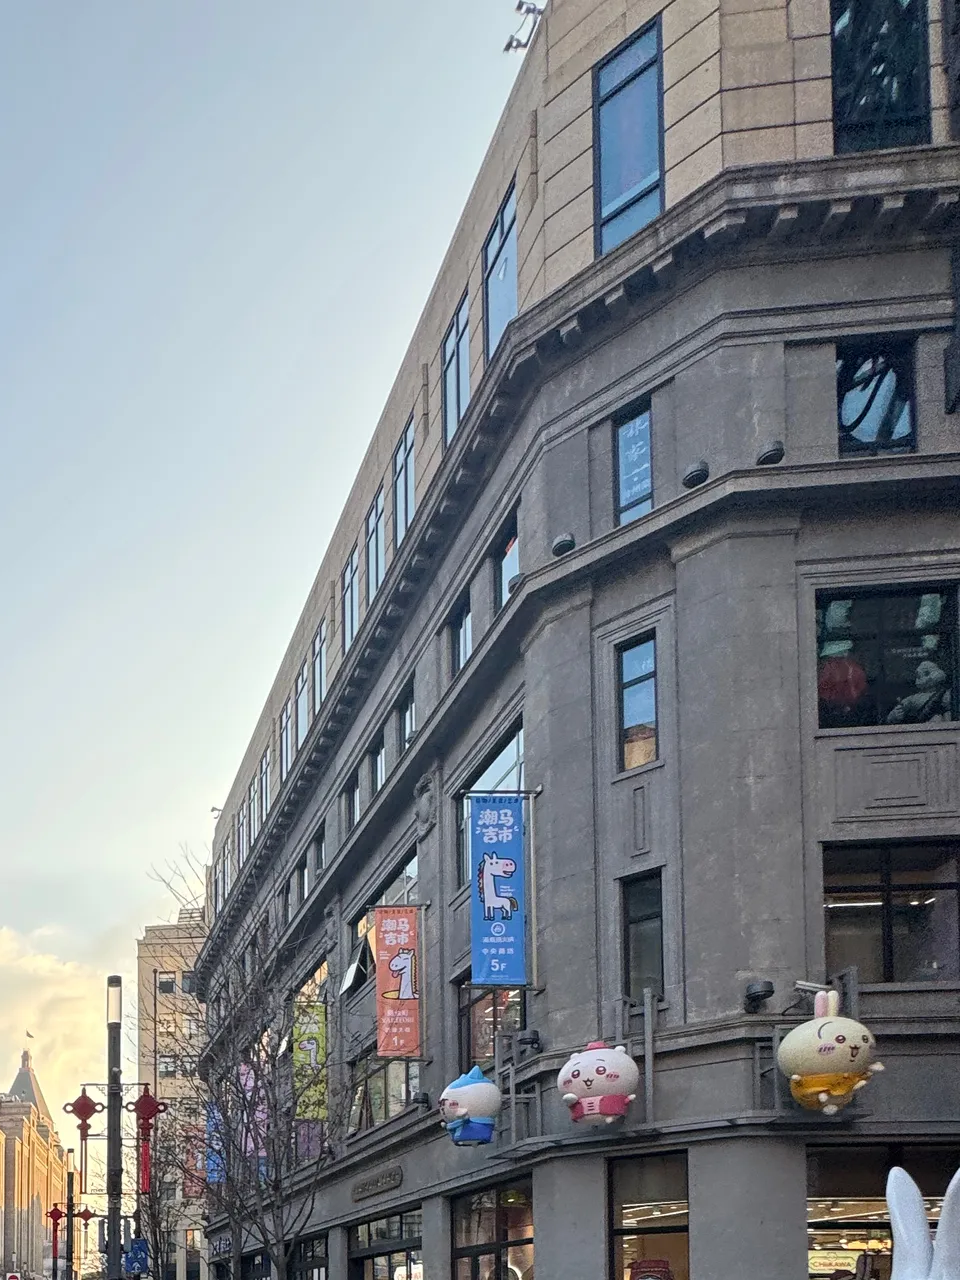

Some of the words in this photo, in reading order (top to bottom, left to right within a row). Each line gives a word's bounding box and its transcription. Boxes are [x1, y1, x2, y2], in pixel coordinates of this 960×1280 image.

[477, 808, 514, 826] 潮马
[481, 826, 513, 843] 吉市
[381, 918, 410, 932] 潮马
[384, 932, 409, 946] 吉市
[490, 959, 507, 972] 5F
